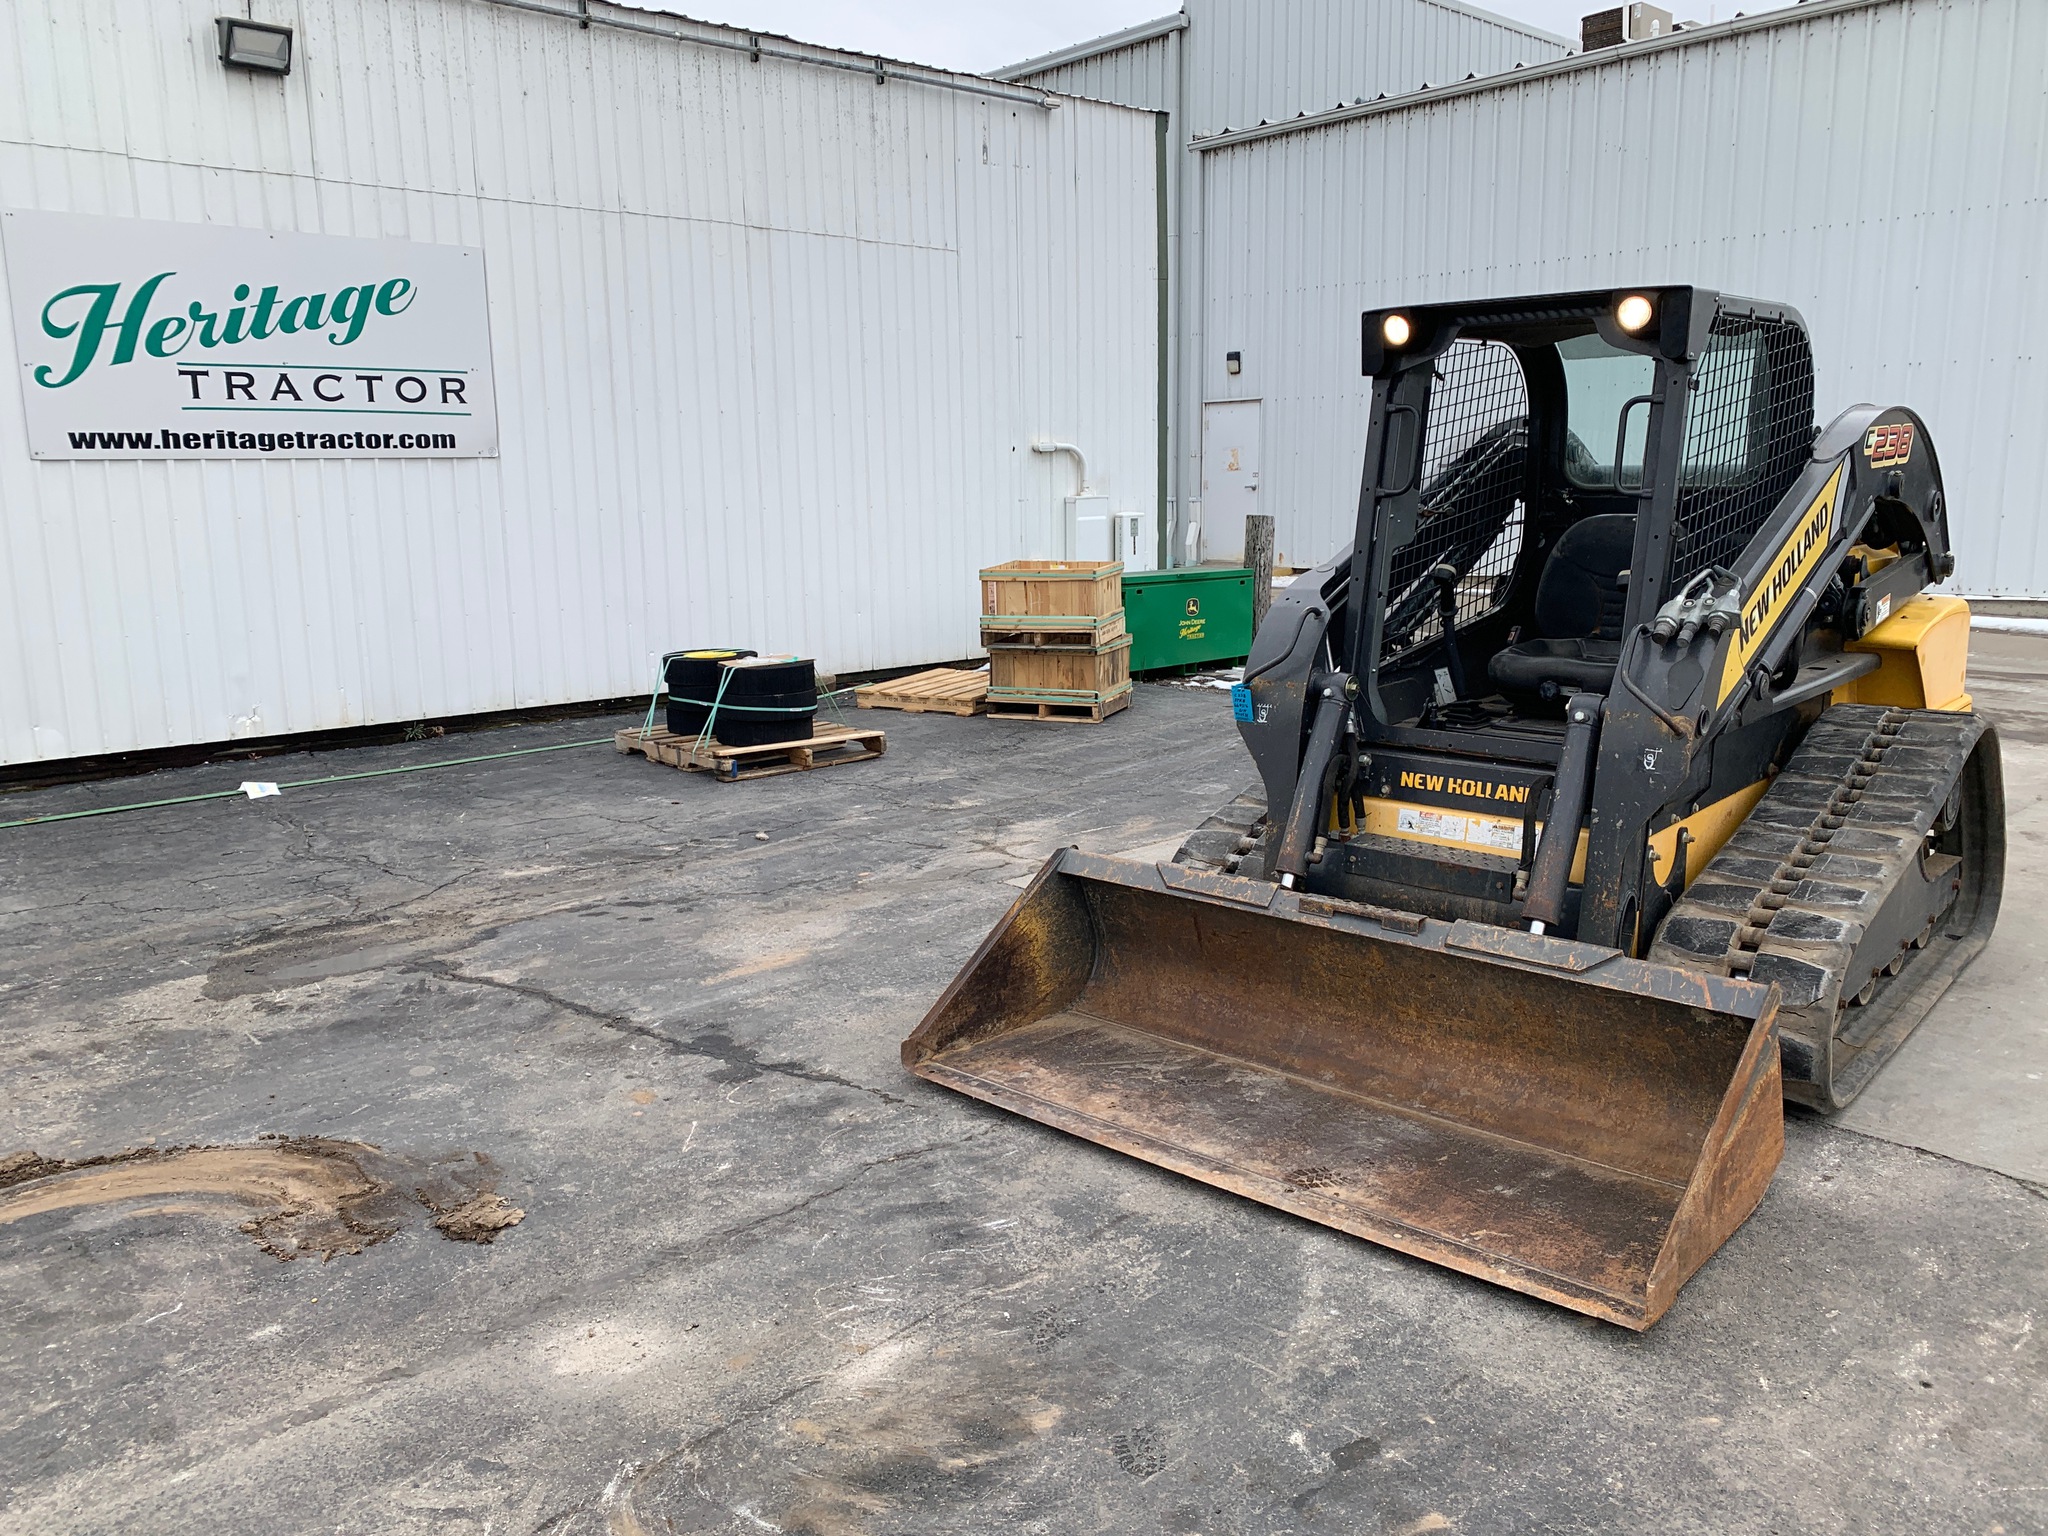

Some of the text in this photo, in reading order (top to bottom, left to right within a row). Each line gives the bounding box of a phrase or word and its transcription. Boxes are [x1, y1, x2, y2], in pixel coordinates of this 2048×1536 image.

[33, 272, 418, 389] Heritage
[177, 368, 468, 404] TRACTOR
[67, 429, 456, 451] www.heritagetractor.com
[1864, 424, 1914, 466] C238
[1739, 501, 1829, 653] NEW HOLLAND
[1400, 771, 1445, 792] NEW
